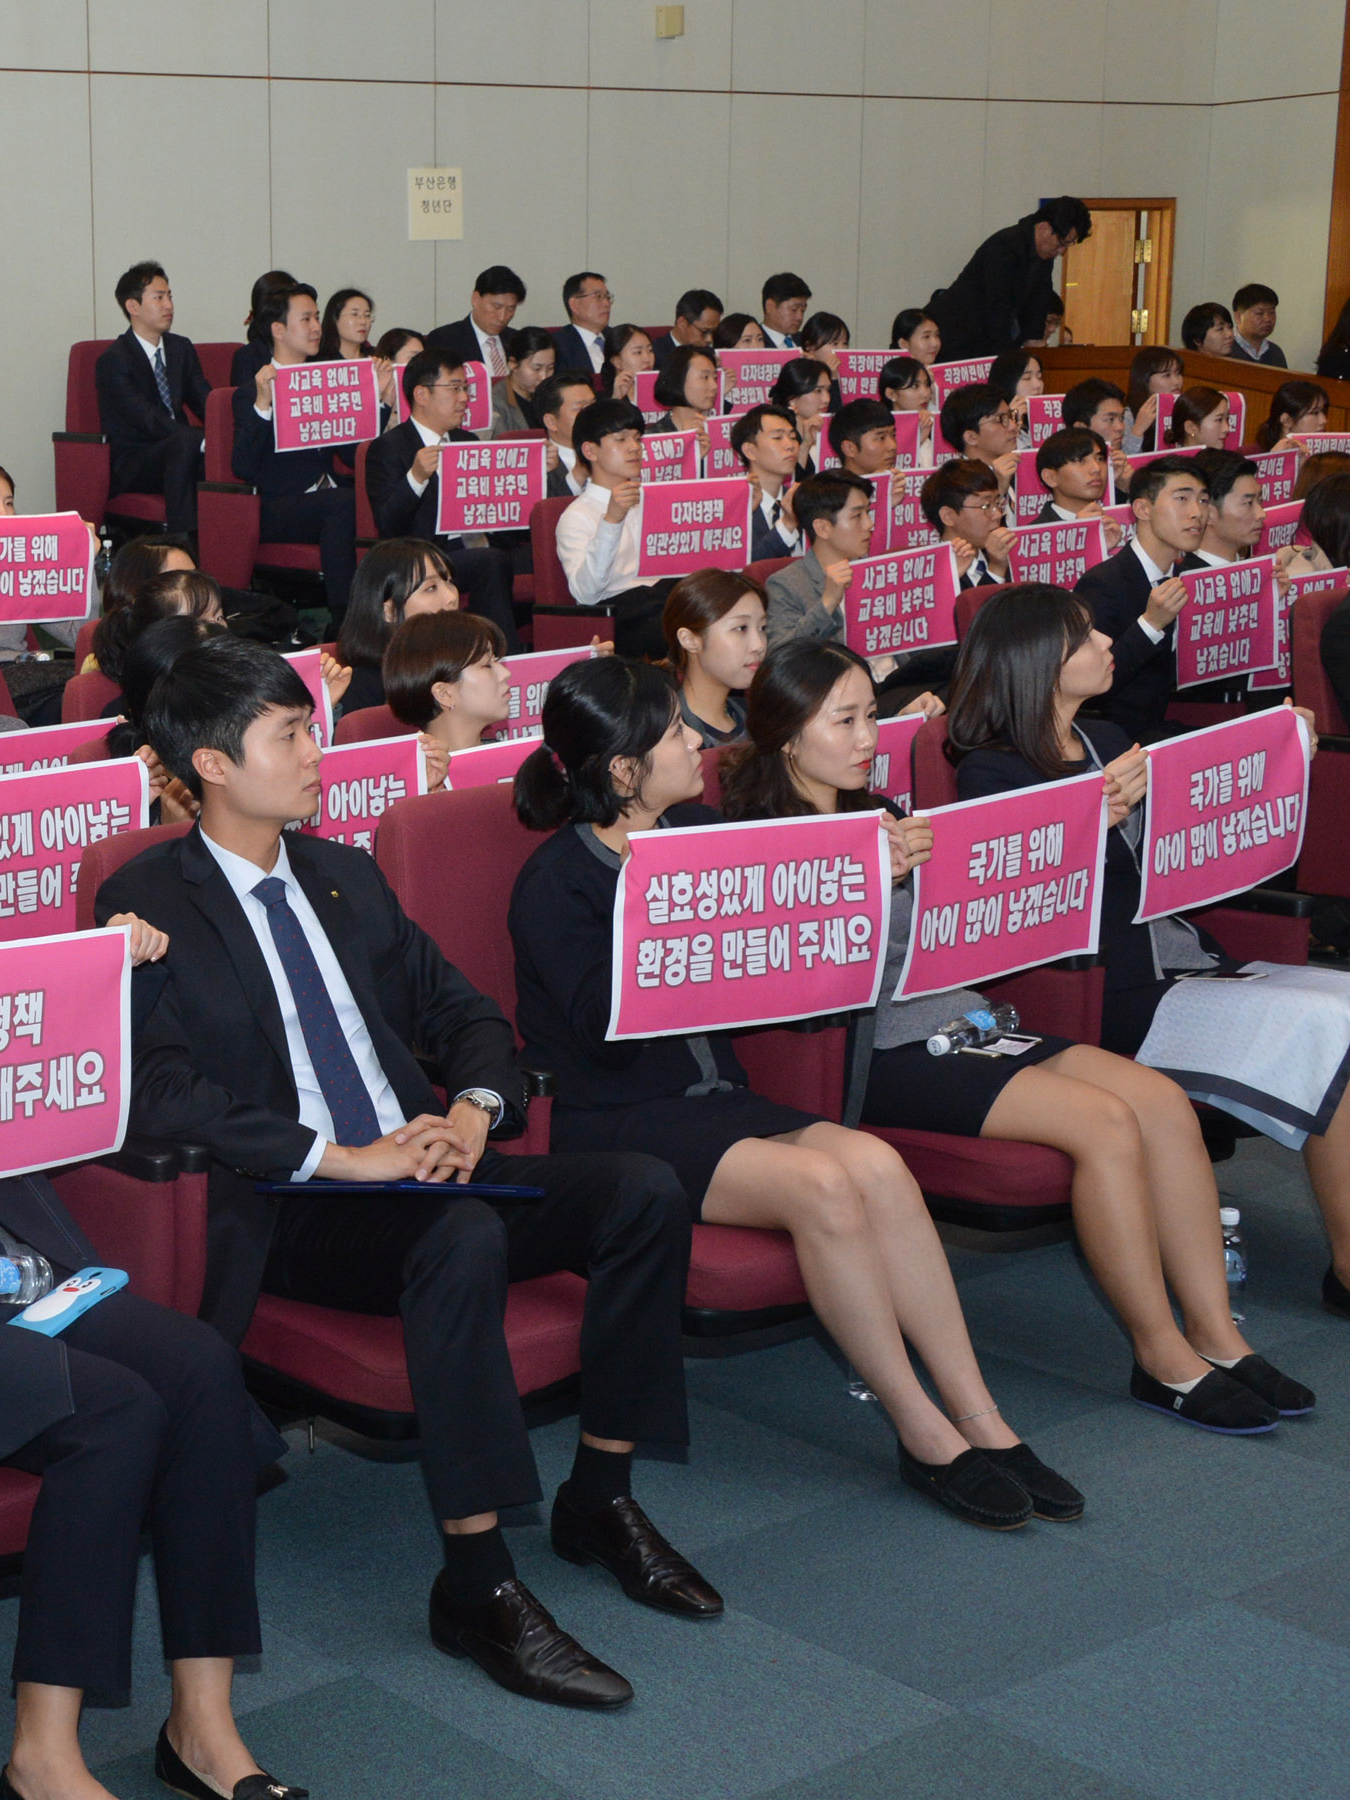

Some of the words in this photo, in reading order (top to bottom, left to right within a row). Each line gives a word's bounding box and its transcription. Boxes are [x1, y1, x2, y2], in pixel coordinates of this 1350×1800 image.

[415, 175, 457, 190] 부산은행
[420, 199, 453, 214] 청년단
[288, 369, 323, 392] 사교육
[327, 366, 360, 389] 없애고
[289, 395, 324, 418] 교육비
[327, 390, 363, 415] 낮추면
[299, 417, 357, 442] 낳겠습니다
[456, 449, 491, 472] 사교육
[496, 447, 529, 470] 없애고
[651, 438, 684, 462] 없애고
[456, 476, 490, 499] 교육비
[494, 473, 529, 497] 낮추면
[463, 501, 521, 526] 낳겠습니다
[671, 499, 724, 525] 다자녀정책
[31, 534, 59, 562] 위해
[646, 531, 700, 557] 일관성있게
[703, 526, 742, 551] 해주세요
[1018, 531, 1051, 558] 사교육
[1056, 527, 1088, 552] 없애고
[18, 567, 85, 598] 낳겠습니다
[861, 563, 898, 591] 사교육
[903, 554, 935, 581] 없애고
[1193, 576, 1227, 606] 사교육
[1230, 567, 1261, 597] 없애고
[858, 594, 897, 622] 교육비
[901, 586, 935, 615] 낮추면
[865, 617, 928, 652] 낳겠습니다
[1190, 609, 1224, 642] 교육비
[1228, 602, 1258, 634] 낮추면
[1196, 638, 1251, 676] 낳겠습니다
[1190, 761, 1233, 813] 국가를
[1238, 750, 1266, 799] 위해
[40, 799, 131, 852] 아이낳는
[1154, 829, 1187, 877] 아이
[1190, 818, 1218, 868] 많이
[1221, 792, 1300, 857] 낳겠습니다
[968, 832, 1023, 886] 국가를
[1028, 821, 1065, 873] 위해
[645, 864, 765, 925] 실효성있게
[771, 855, 866, 909] 아이낳는
[920, 902, 960, 952] 아이
[964, 893, 1003, 944] 많이
[1007, 868, 1089, 934] 낳겠습니다
[636, 934, 714, 988] 환경을
[721, 924, 791, 979] 만들어
[798, 914, 872, 969] 주세요
